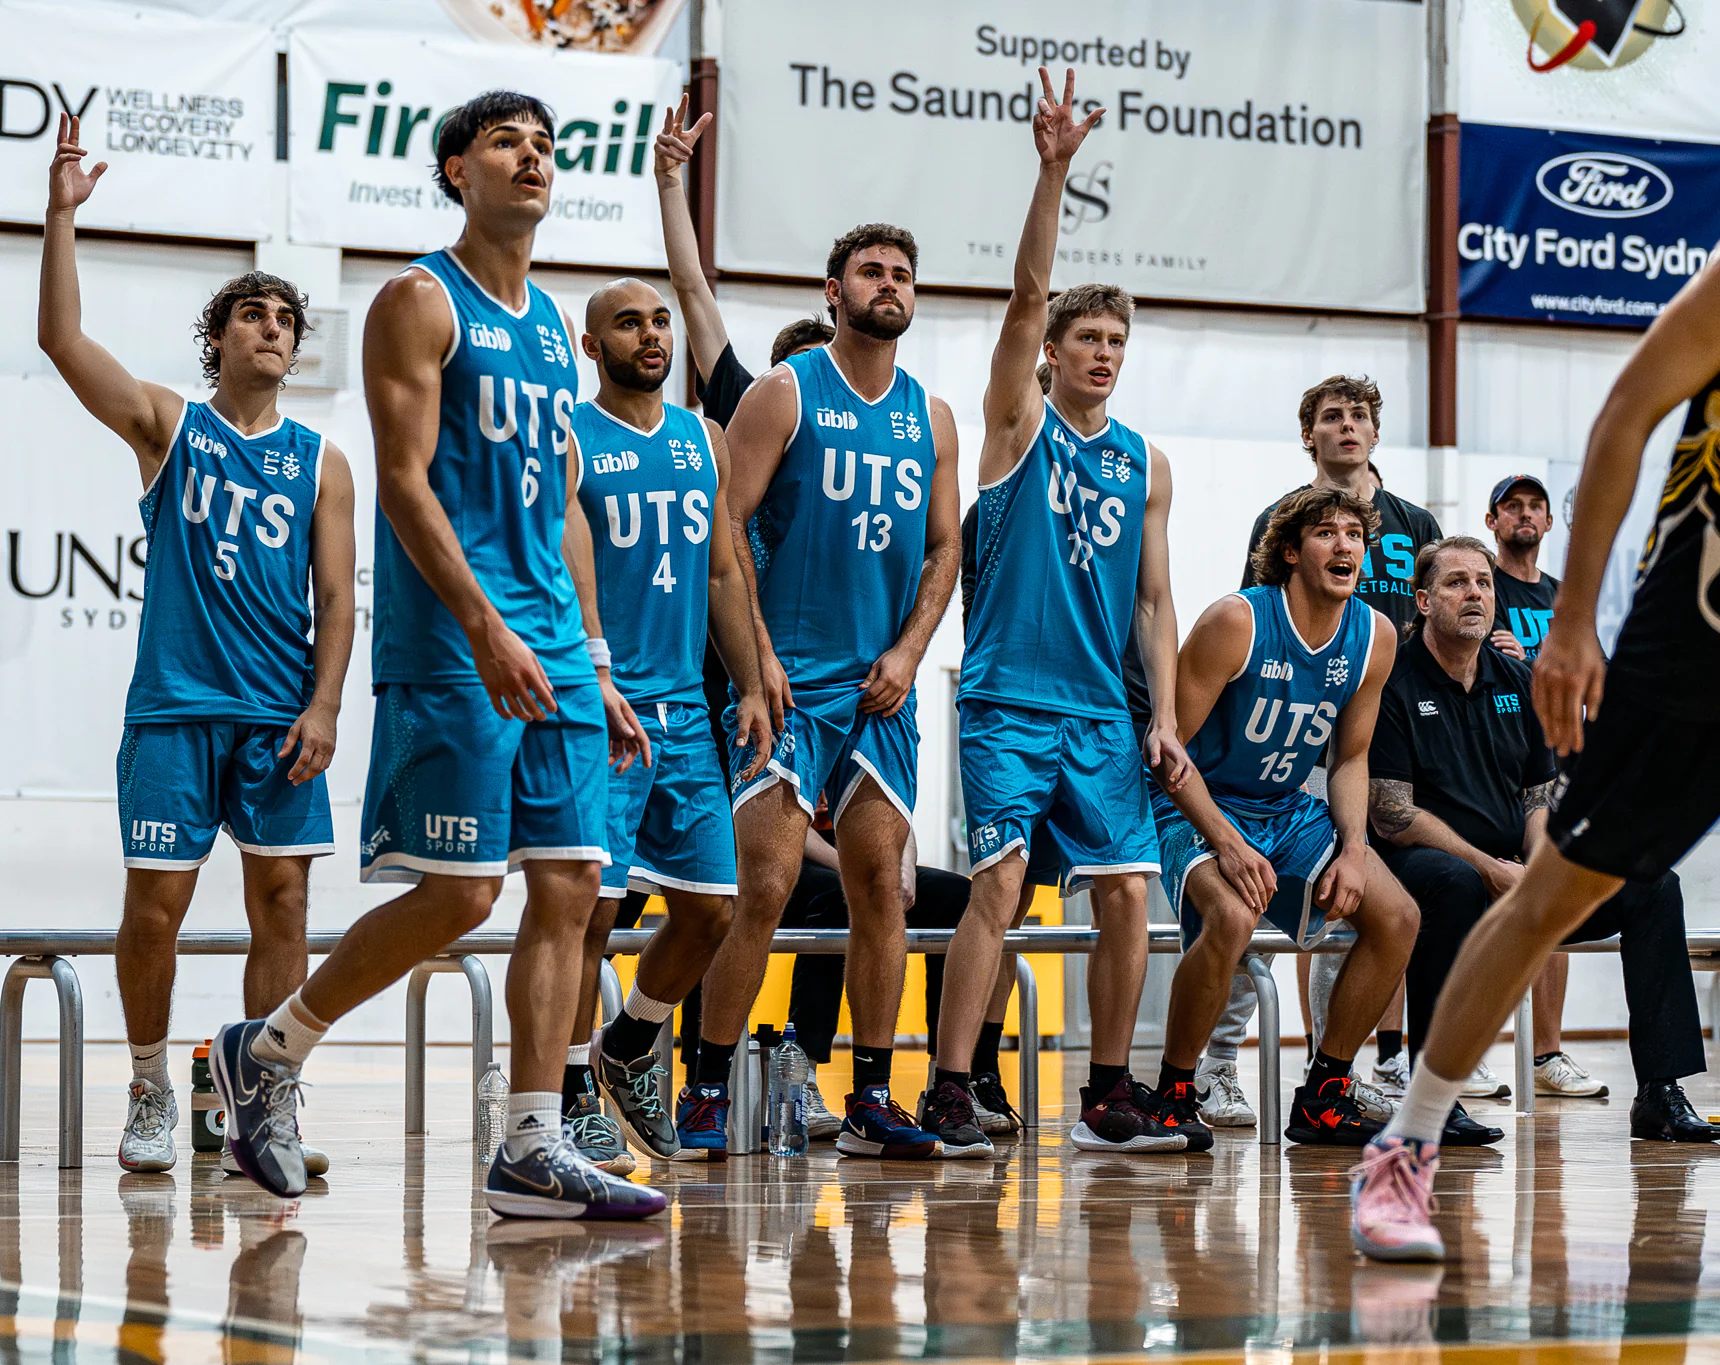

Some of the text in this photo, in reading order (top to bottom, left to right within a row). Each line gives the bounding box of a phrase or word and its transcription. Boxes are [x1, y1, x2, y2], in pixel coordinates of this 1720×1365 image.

[976, 24, 1190, 79] Supported by
[106, 87, 244, 119] WELLNESS
[789, 62, 1362, 148] The Saunds Foundation
[107, 111, 235, 137] RECOVERY
[317, 80, 655, 176] Firail
[106, 132, 254, 162] LONGEVITY
[349, 179, 423, 209] Invest
[1559, 159, 1650, 209] Ford
[547, 192, 624, 222] viction
[967, 242, 1208, 271] THE NDERS FAMILY
[1458, 222, 1716, 280] City Ford Sydn
[536, 324, 556, 363] UTS
[479, 375, 575, 456] UTS
[890, 411, 906, 440] UTS
[263, 449, 281, 476] UTS
[668, 439, 687, 470] UTS
[1101, 449, 1115, 479] UTS
[521, 457, 542, 509] 6
[822, 447, 923, 511] UTS
[182, 467, 295, 549] UTS
[604, 489, 709, 548] UTS
[1047, 461, 1126, 547] UTS
[851, 511, 893, 552] 13
[213, 541, 239, 581] 5
[652, 552, 677, 594] 4
[1354, 580, 1414, 597] ETBALL
[60, 607, 141, 631] SYD
[1508, 607, 1555, 647] UT
[1493, 694, 1519, 708] UTS
[1496, 706, 1522, 714] SPORT
[1244, 697, 1337, 747] UTS
[1258, 751, 1299, 783] 15
[131, 819, 177, 843] UTS
[425, 813, 479, 842] UTS
[971, 821, 999, 849] UTS
[130, 841, 176, 853] SPORT
[426, 840, 478, 854] SPORT
